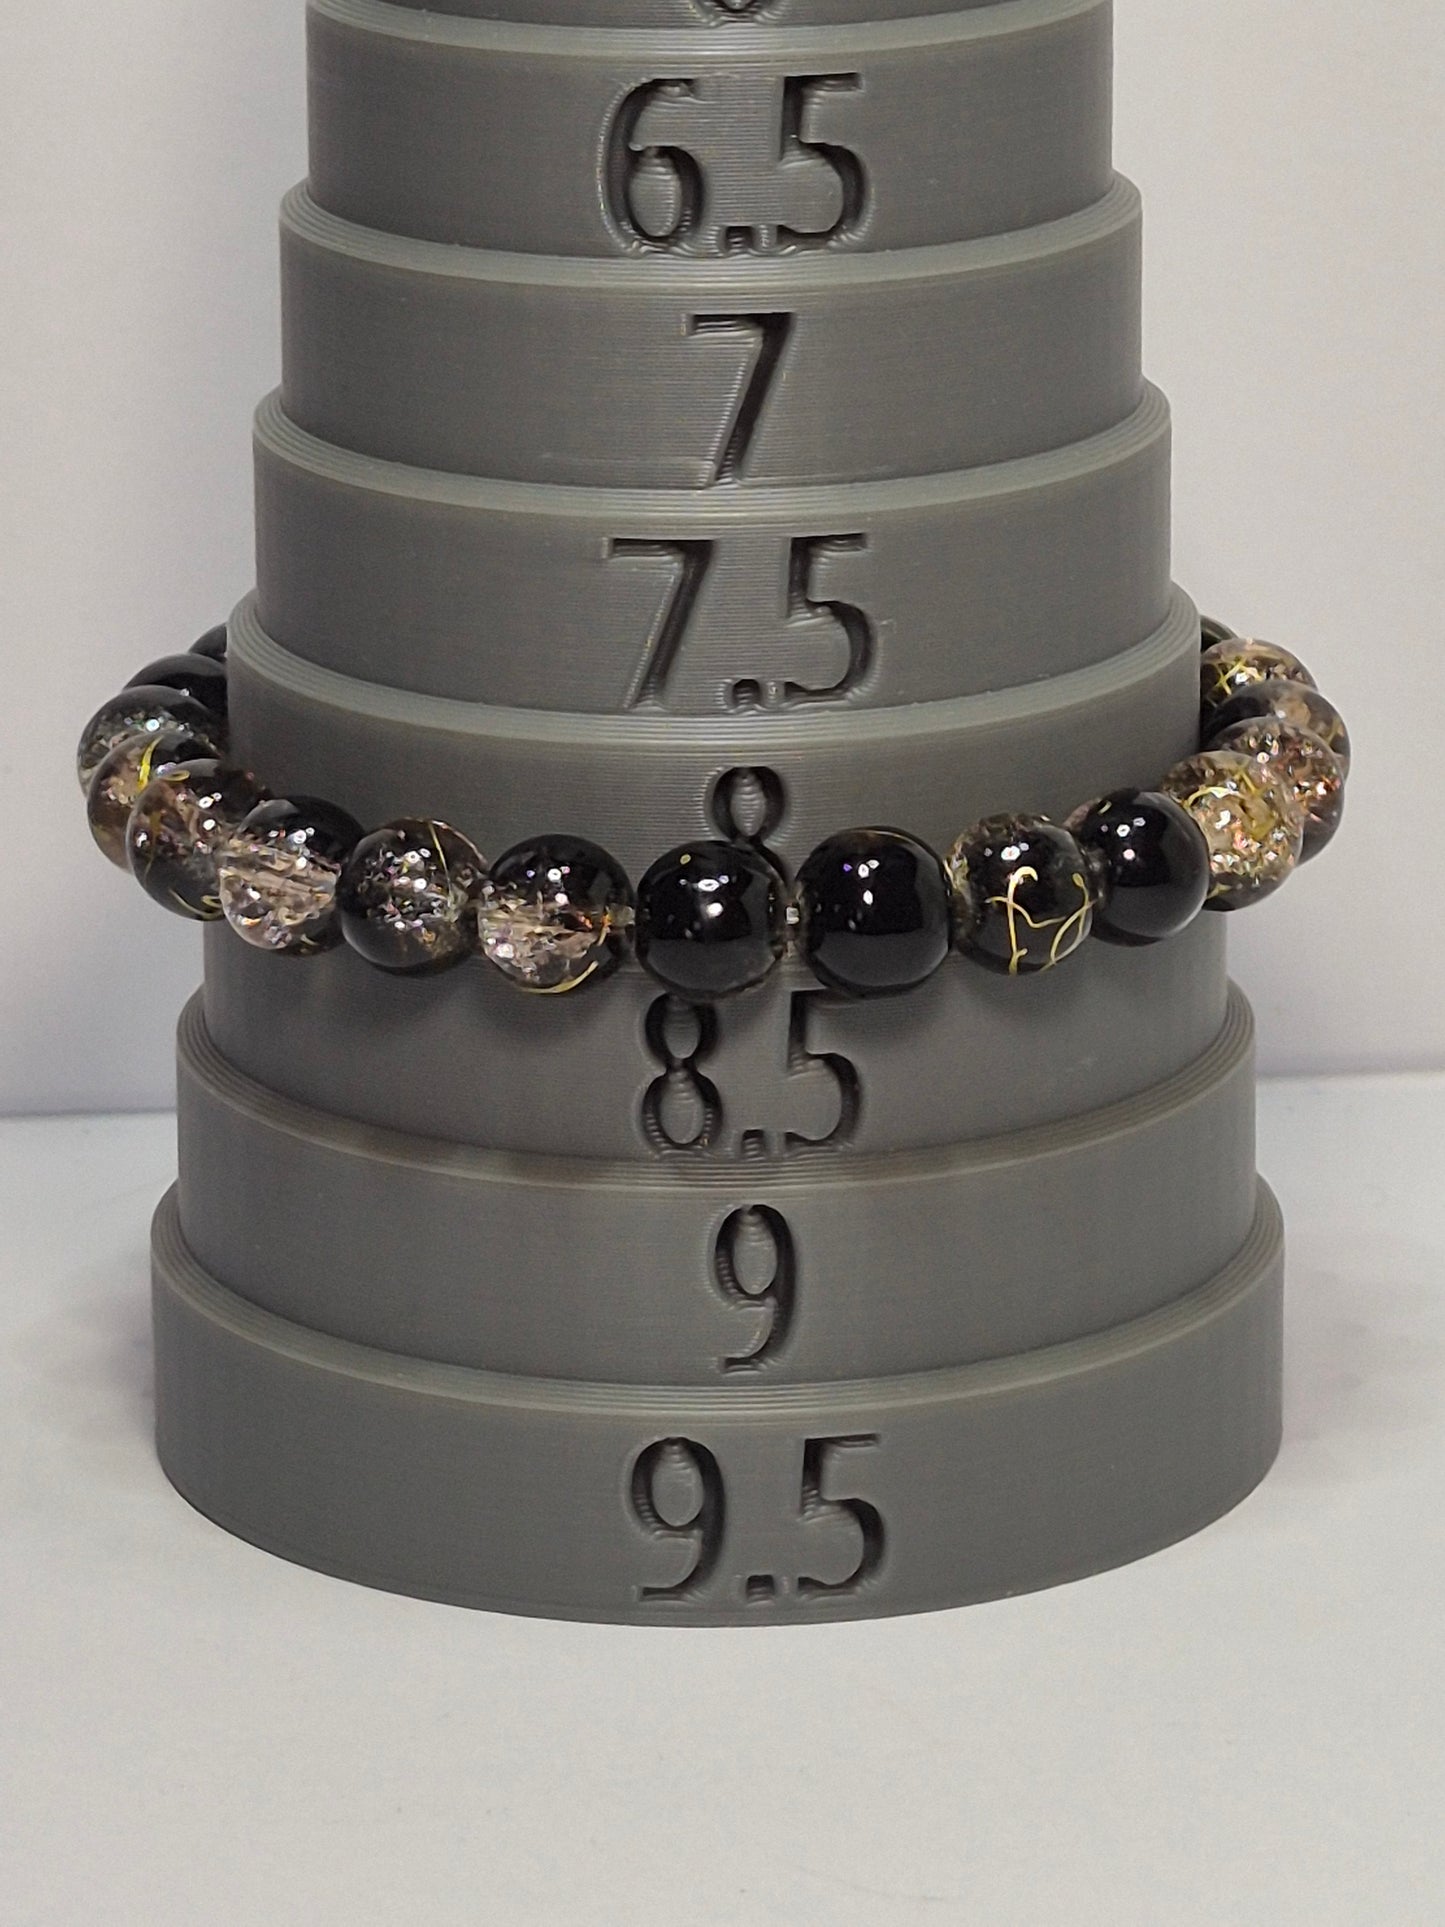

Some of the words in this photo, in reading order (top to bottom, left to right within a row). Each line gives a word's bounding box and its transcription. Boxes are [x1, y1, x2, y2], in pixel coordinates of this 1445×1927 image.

[599, 72, 872, 254] 6.5
[684, 312, 796, 488] 7
[603, 533, 879, 711] 7.5
[640, 989, 863, 1157] 8.5
[709, 1203, 797, 1374] 9
[627, 1433, 886, 1602] 9.5
